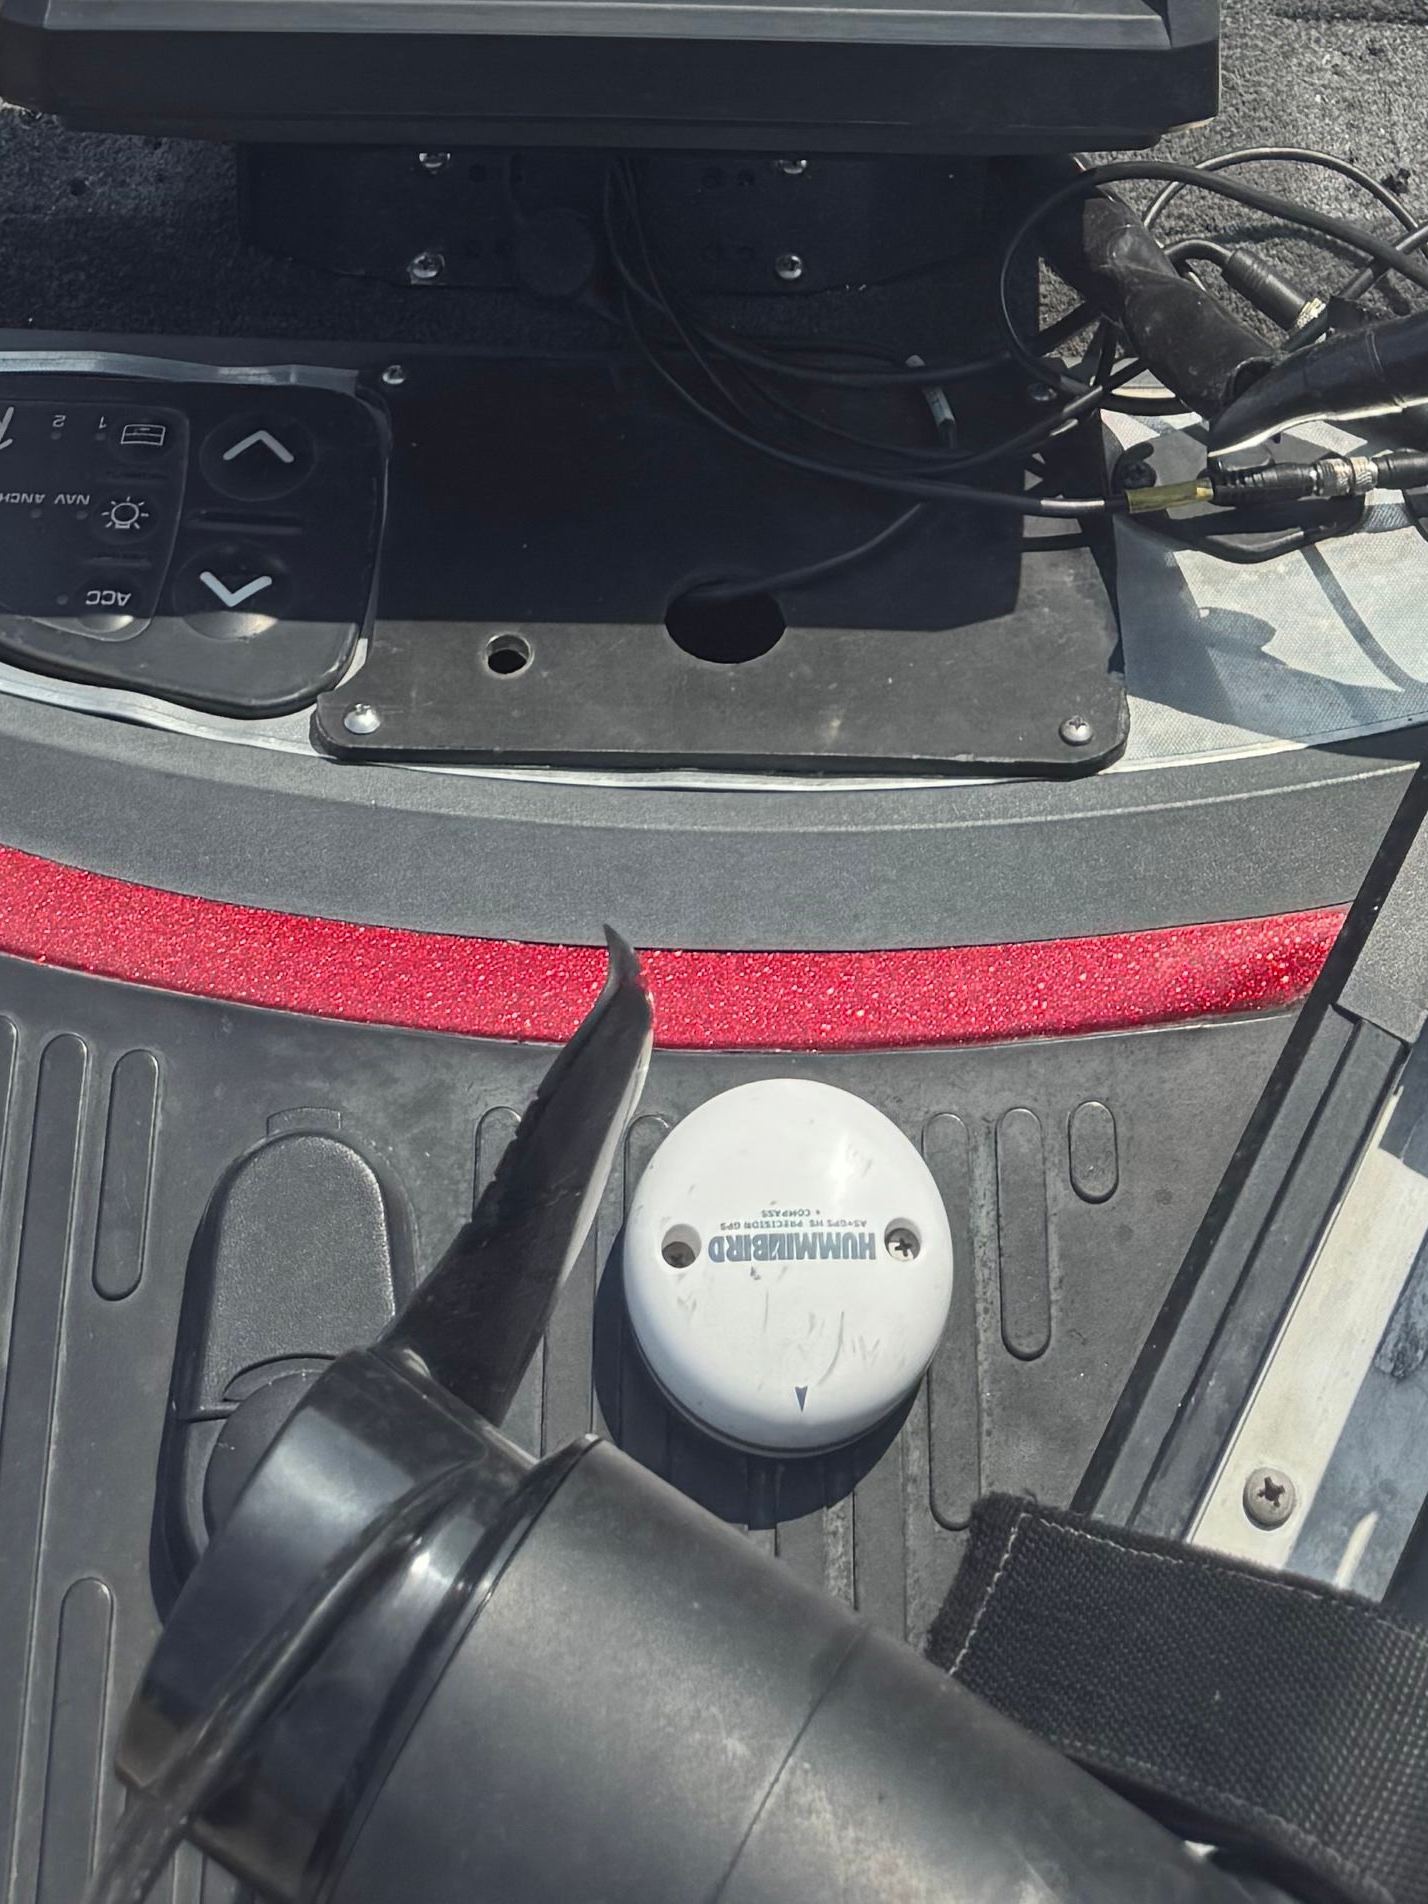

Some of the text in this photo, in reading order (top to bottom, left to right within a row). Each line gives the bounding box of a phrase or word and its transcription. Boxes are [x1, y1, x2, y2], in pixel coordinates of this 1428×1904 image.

[52, 414, 67, 428] 2
[98, 415, 108, 430] 1
[54, 493, 91, 505] NAV
[85, 589, 132, 607] ACC
[760, 1208, 812, 1219] COMPASS
[719, 1221, 741, 1231] GPS
[743, 1219, 804, 1230] PRECISION
[707, 1231, 877, 1263] HUMMINBIRD
